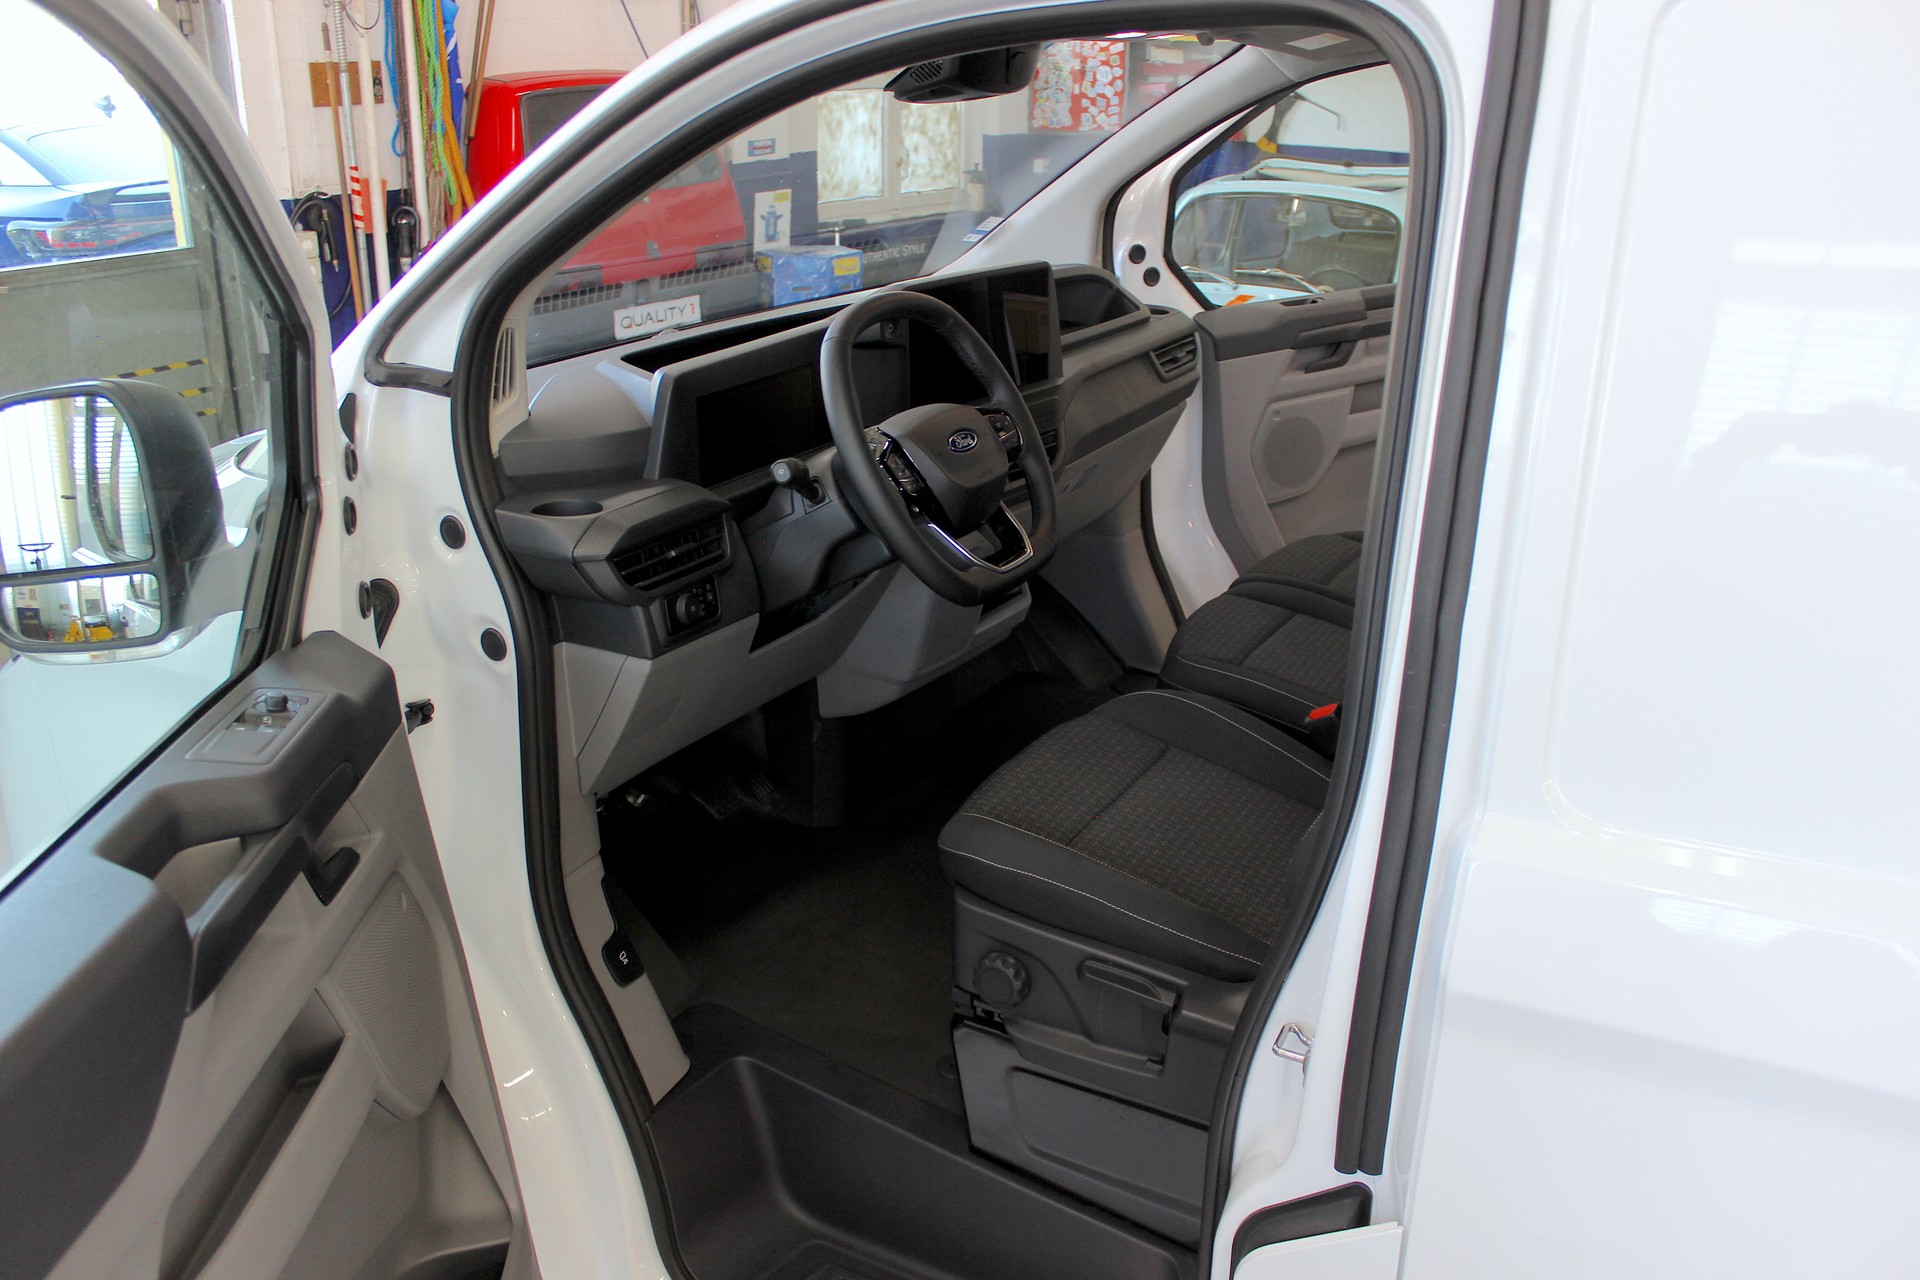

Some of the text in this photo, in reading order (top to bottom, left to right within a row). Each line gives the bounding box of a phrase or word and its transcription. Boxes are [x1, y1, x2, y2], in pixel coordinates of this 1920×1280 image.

[863, 243, 926, 264] UTHENTIC STYLE
[954, 434, 974, 448] Ford
